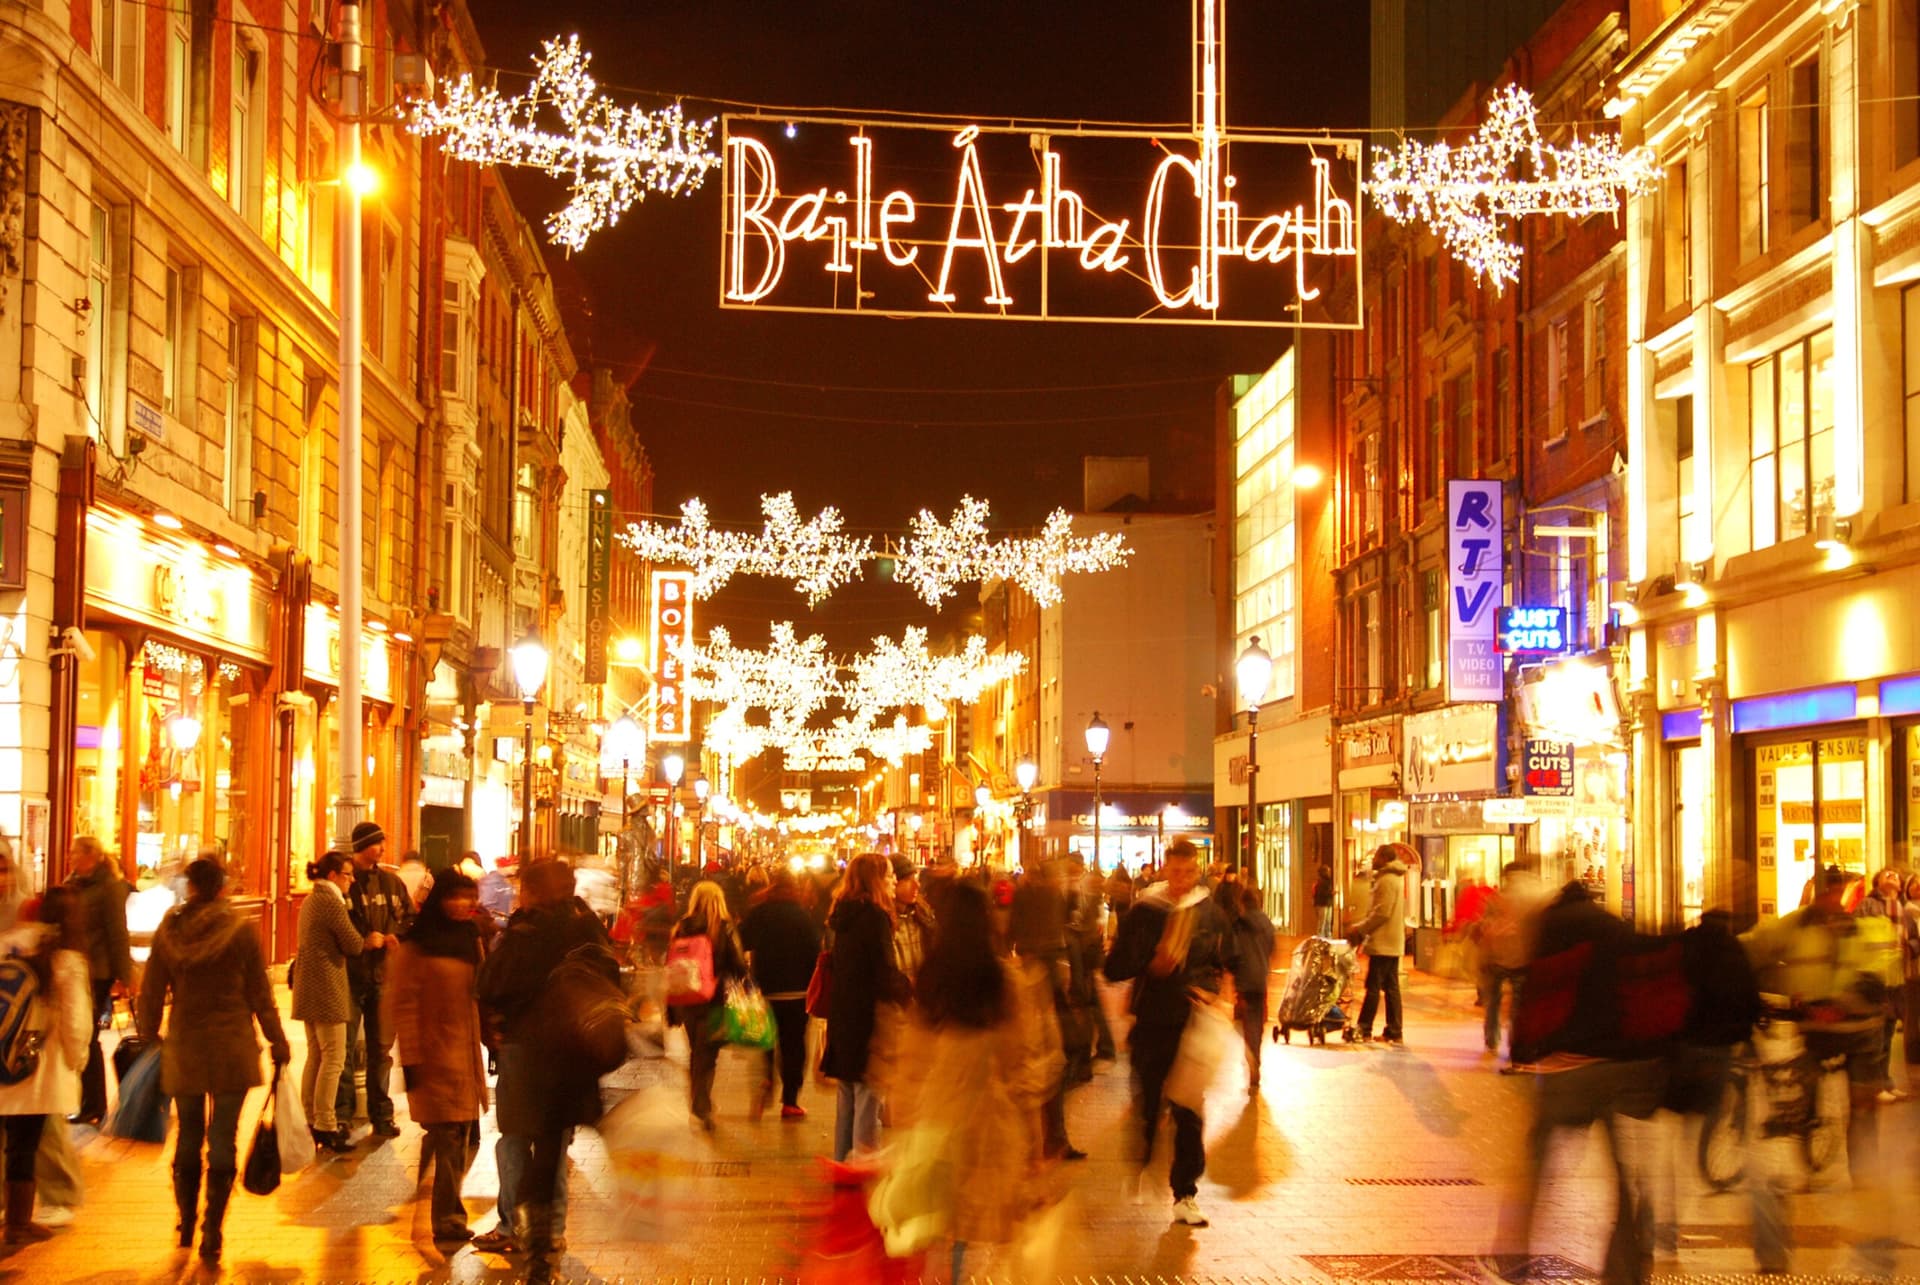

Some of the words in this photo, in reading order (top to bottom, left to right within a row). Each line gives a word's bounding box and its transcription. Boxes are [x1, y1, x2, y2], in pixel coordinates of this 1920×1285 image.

[727, 136, 919, 303] Baile
[1456, 491, 1496, 627] RTV
[1508, 609, 1560, 628] JUST
[588, 587, 604, 678] STORES
[1506, 629, 1562, 649] CUTS
[660, 581, 683, 731] BOYERS
[1458, 659, 1495, 671] VIDEO
[1463, 675, 1491, 686] HI-FI
[1530, 742, 1568, 754] JUST
[1760, 744, 1799, 763] VALUE
[1529, 757, 1570, 770] CUTS
